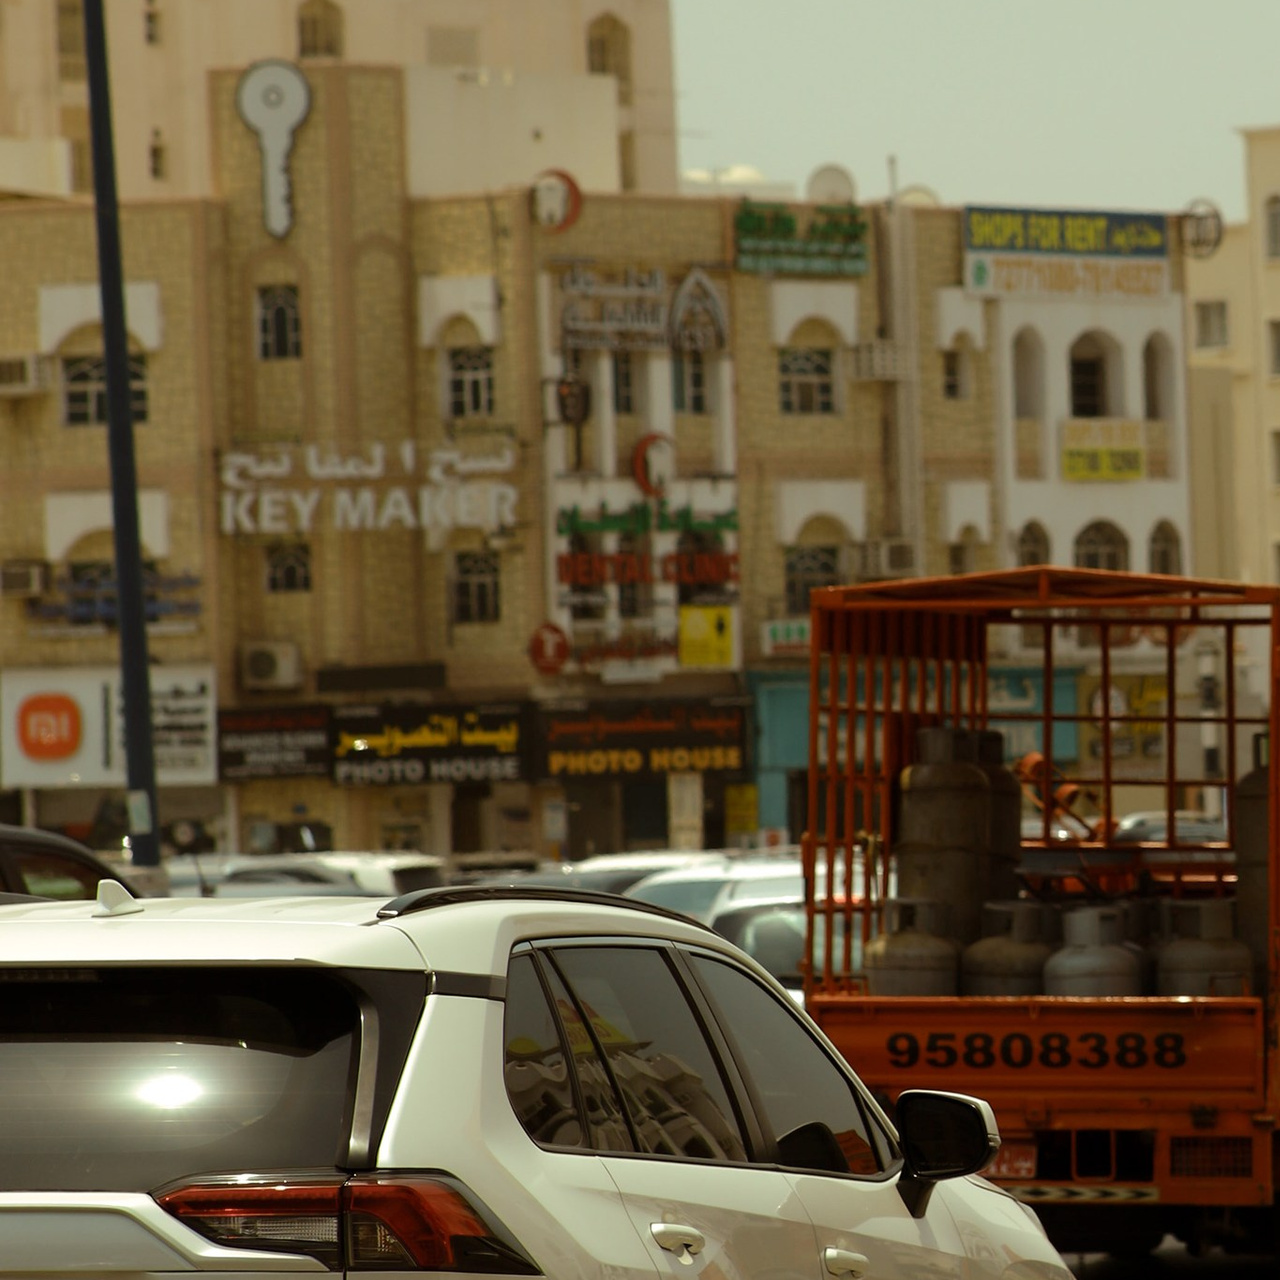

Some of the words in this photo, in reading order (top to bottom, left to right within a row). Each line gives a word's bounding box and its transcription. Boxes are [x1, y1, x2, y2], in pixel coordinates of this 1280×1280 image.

[969, 211, 1025, 249] SHOPS
[1028, 214, 1061, 250] FOR
[1064, 215, 1108, 251] RENT
[220, 487, 322, 535] KEY
[333, 482, 520, 530] MAKER
[556, 553, 656, 586] DENTAL
[335, 759, 425, 785] PHOTO
[430, 756, 519, 781] HOUSE
[548, 748, 643, 775] PHOTO
[650, 746, 741, 770] HOUSE
[886, 1031, 1188, 1069] 95808388
